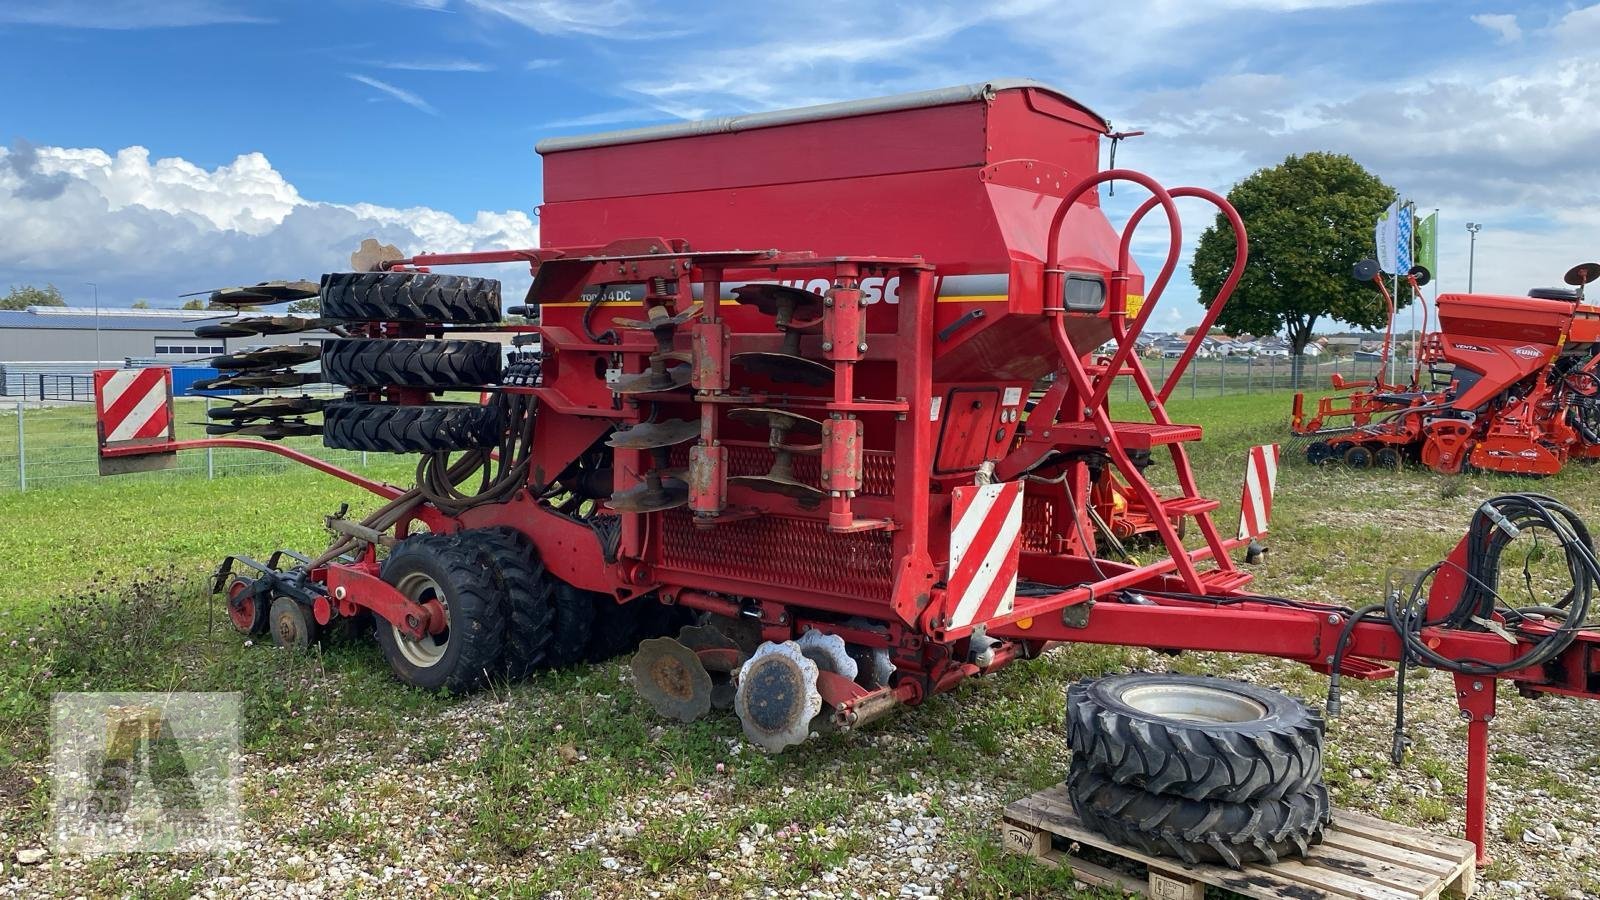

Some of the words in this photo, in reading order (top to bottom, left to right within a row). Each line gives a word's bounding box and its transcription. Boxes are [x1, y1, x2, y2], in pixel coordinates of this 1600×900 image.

[608, 291, 615, 302] 4
[616, 290, 631, 302] DC
[380, 322, 387, 332] 5
[1455, 343, 1478, 351] VENTA
[1515, 348, 1539, 358] KUHN
